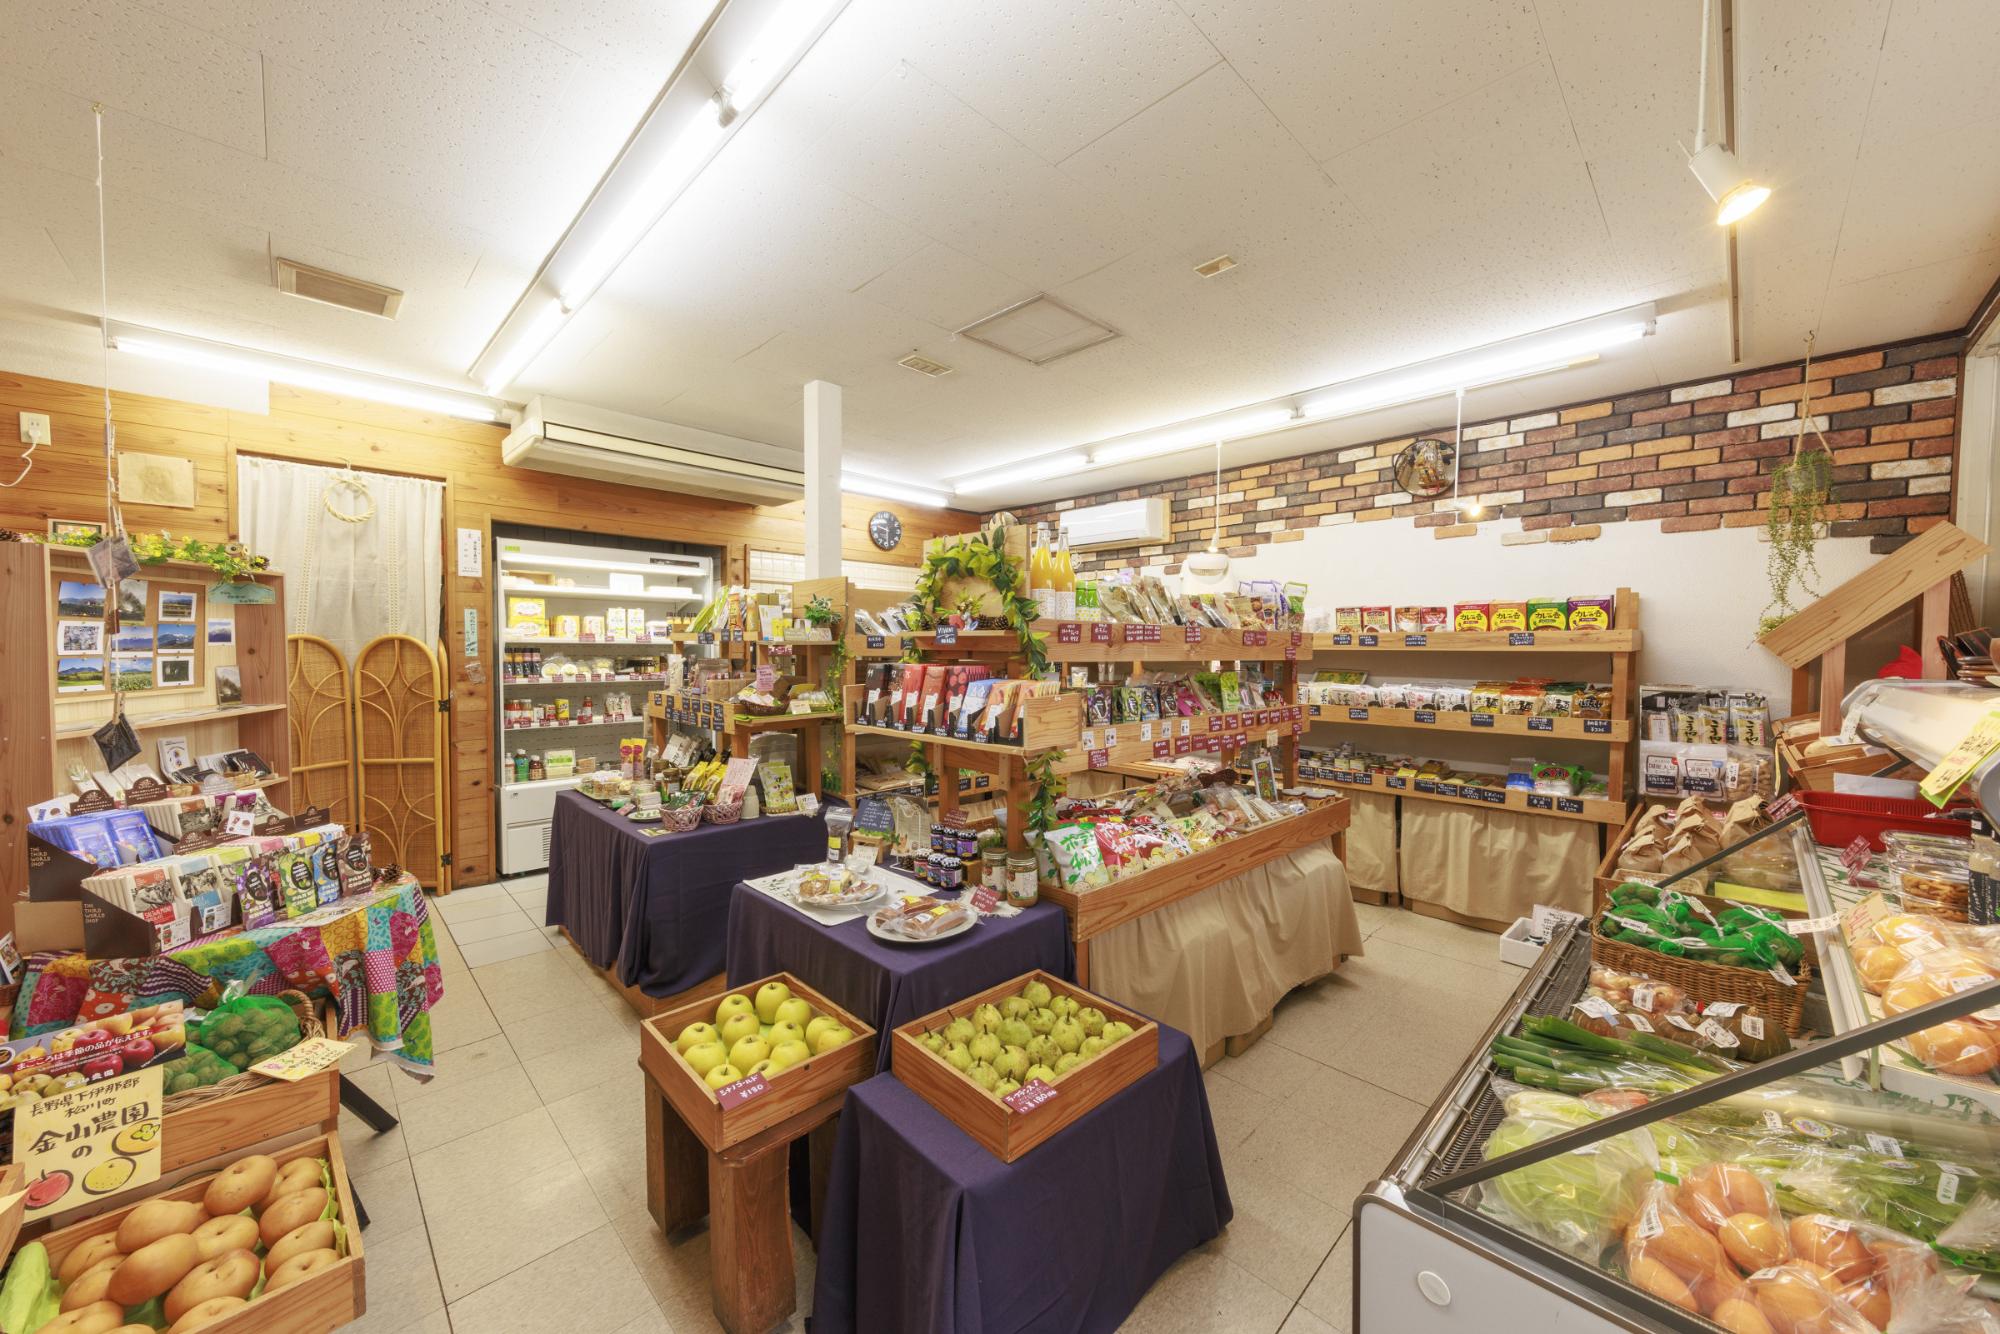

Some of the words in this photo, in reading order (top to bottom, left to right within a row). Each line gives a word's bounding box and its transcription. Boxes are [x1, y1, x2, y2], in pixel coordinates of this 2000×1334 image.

[31, 1077, 140, 1117] 長野県下伊那郡
[64, 1097, 117, 1118] 松川町
[27, 1101, 150, 1156] 金山農園
[71, 1145, 93, 1159] の
